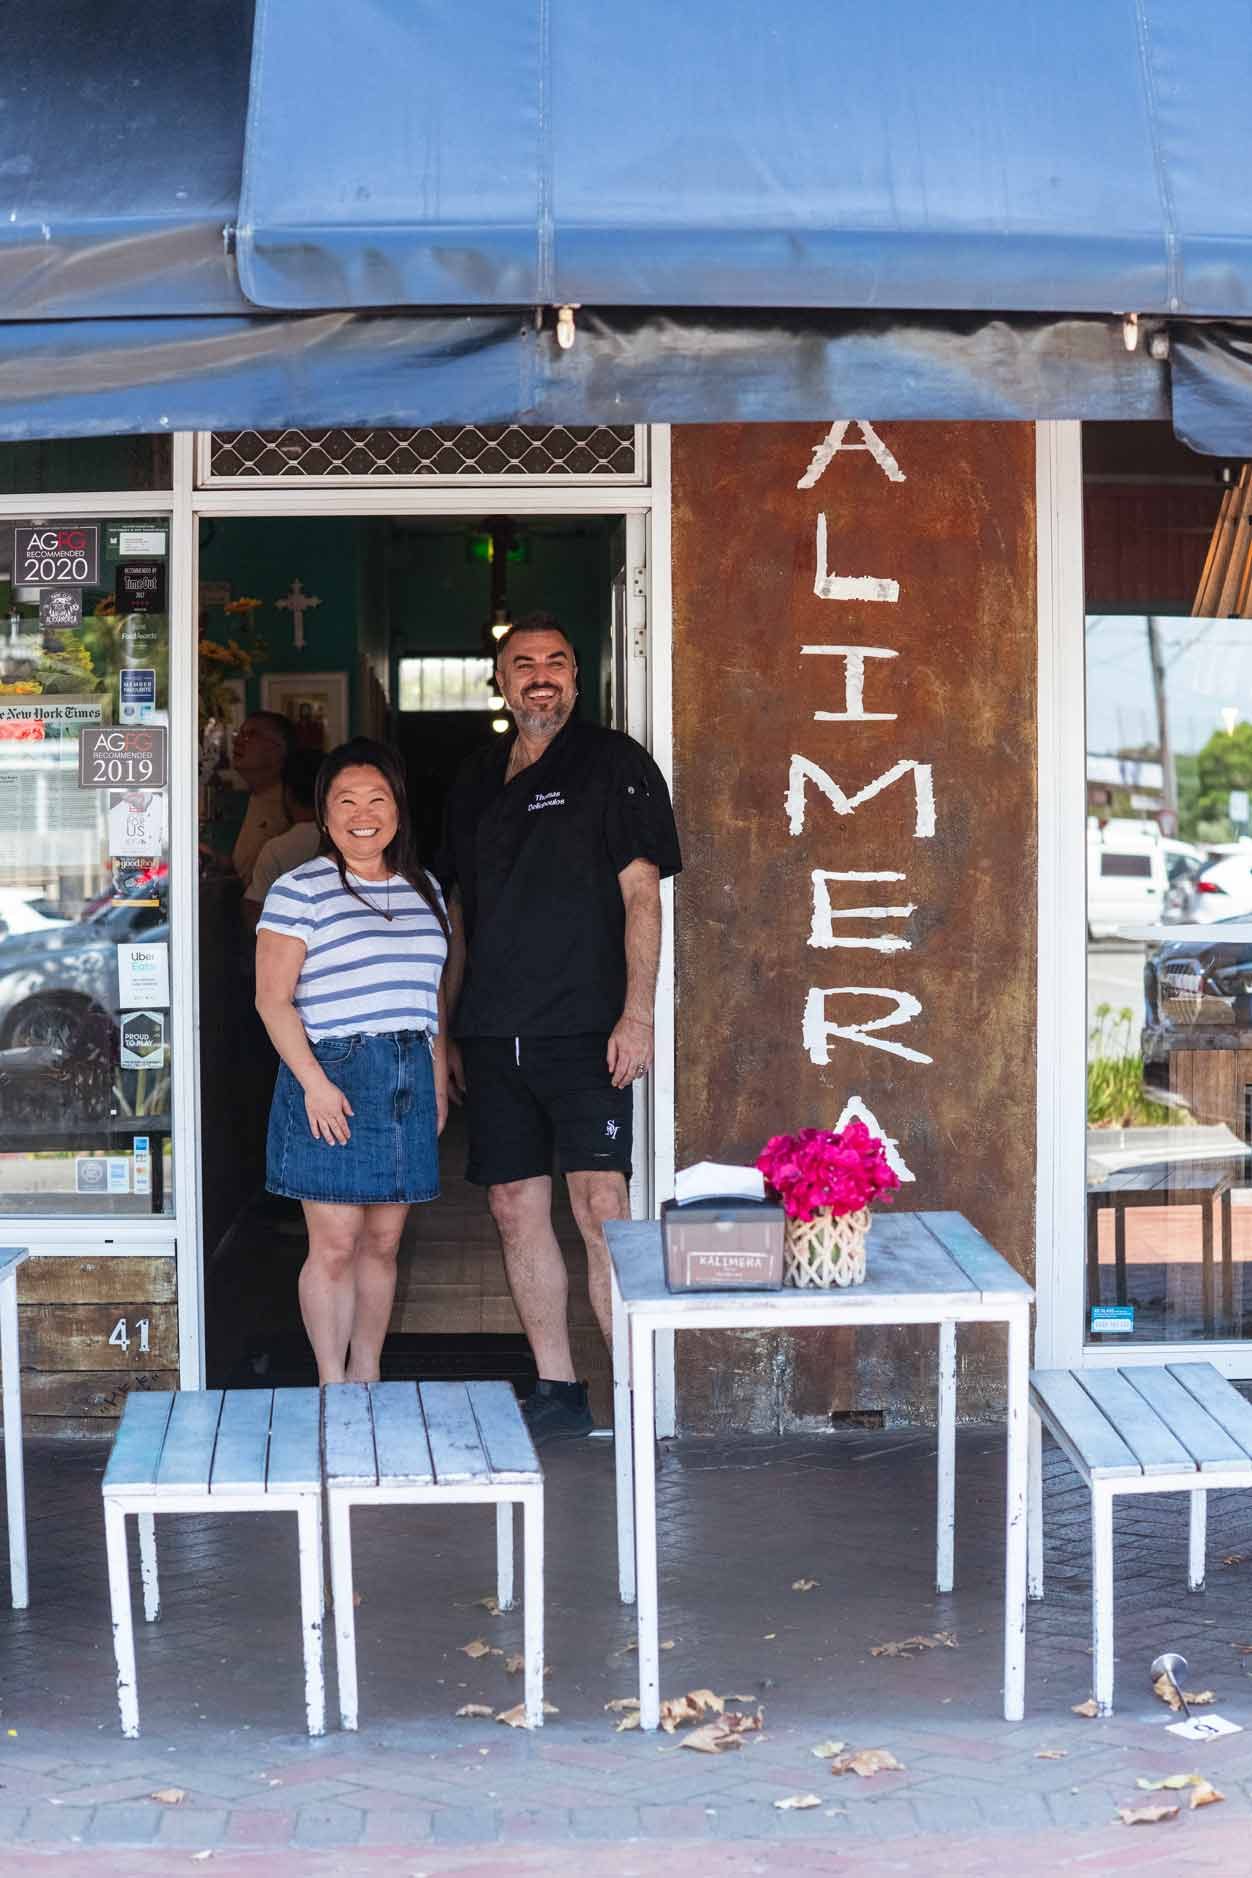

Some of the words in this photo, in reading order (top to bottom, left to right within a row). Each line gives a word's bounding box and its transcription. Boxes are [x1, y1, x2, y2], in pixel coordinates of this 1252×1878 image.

[27, 531, 88, 550] AGFG
[24, 558, 88, 581] 2020
[7, 708, 31, 720] New
[33, 707, 62, 721] York
[64, 706, 100, 719] Times
[94, 733, 152, 751] AGFG
[93, 760, 152, 781] 2019
[131, 952, 154, 960] Uber
[700, 1256, 762, 1269] KALIMERA
[109, 1319, 150, 1352] 41
